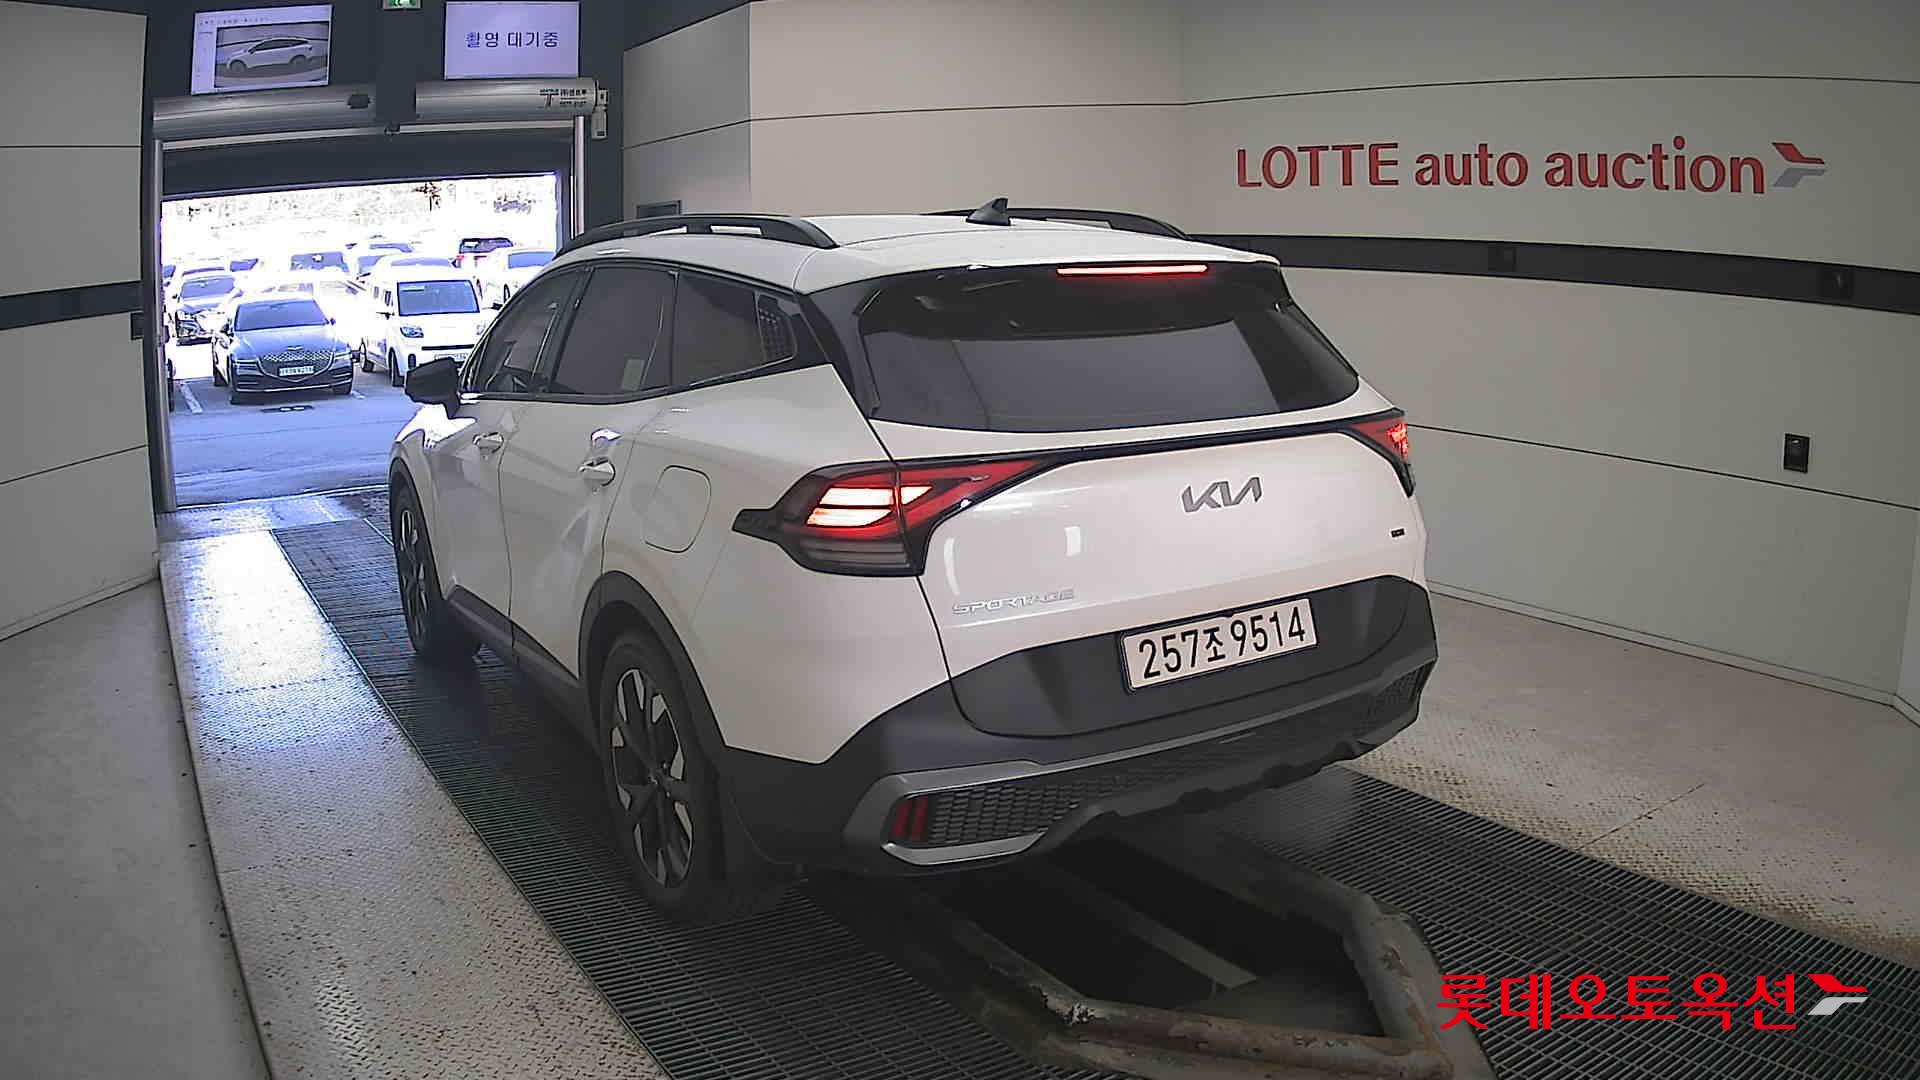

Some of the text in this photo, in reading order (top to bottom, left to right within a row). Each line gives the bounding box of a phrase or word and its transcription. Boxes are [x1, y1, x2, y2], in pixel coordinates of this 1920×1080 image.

[507, 32, 559, 48] 대기중
[1236, 135, 1765, 194] LOTTE auto auction
[1181, 476, 1263, 513] KIA
[952, 587, 1074, 616] SPORTAGE
